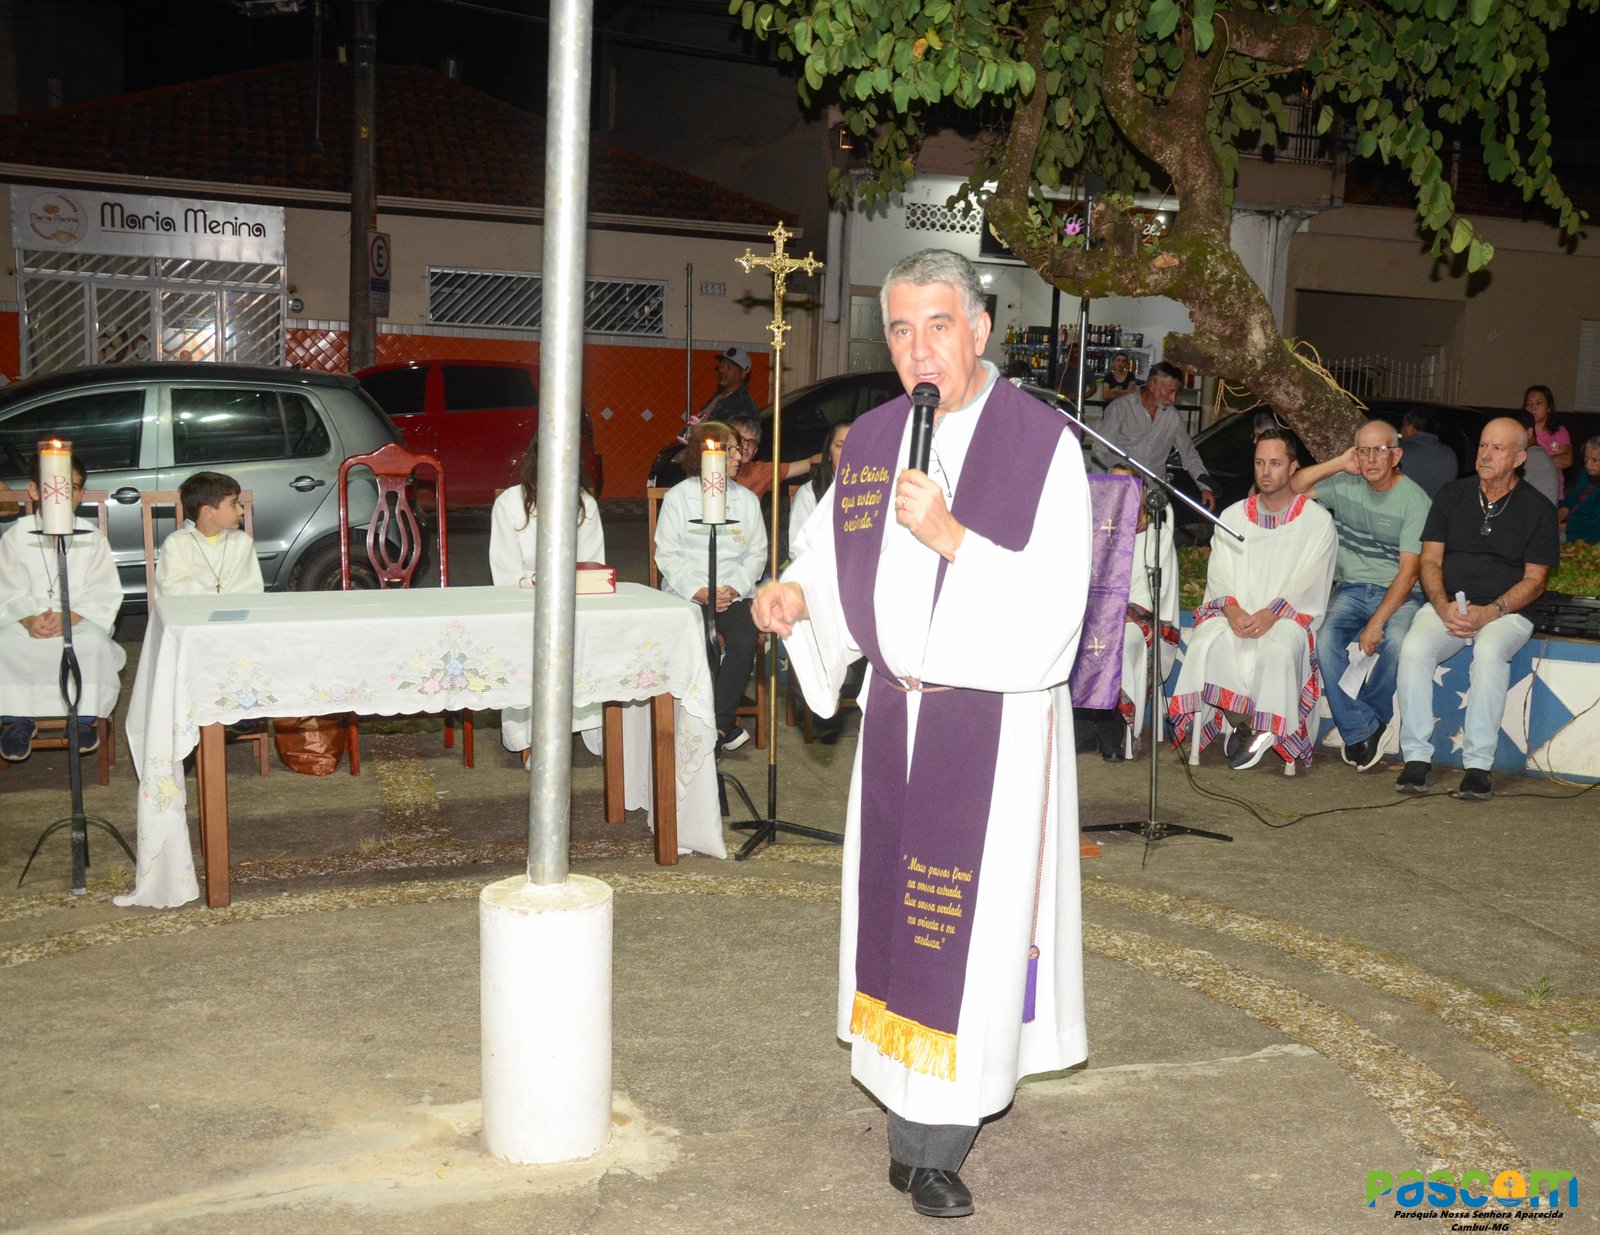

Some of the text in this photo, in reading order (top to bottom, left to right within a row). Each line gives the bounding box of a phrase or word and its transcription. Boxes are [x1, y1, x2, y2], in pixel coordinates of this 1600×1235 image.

[101, 202, 266, 238] Maria Menina
[376, 245, 383, 267] E
[852, 473, 857, 484] a
[927, 866, 950, 879] passos
[952, 866, 973, 883] firmei
[906, 879, 916, 889] na
[917, 882, 935, 894] vossa
[903, 892, 962, 917] Que vossa verdade
[907, 915, 955, 934] me orienta e me
